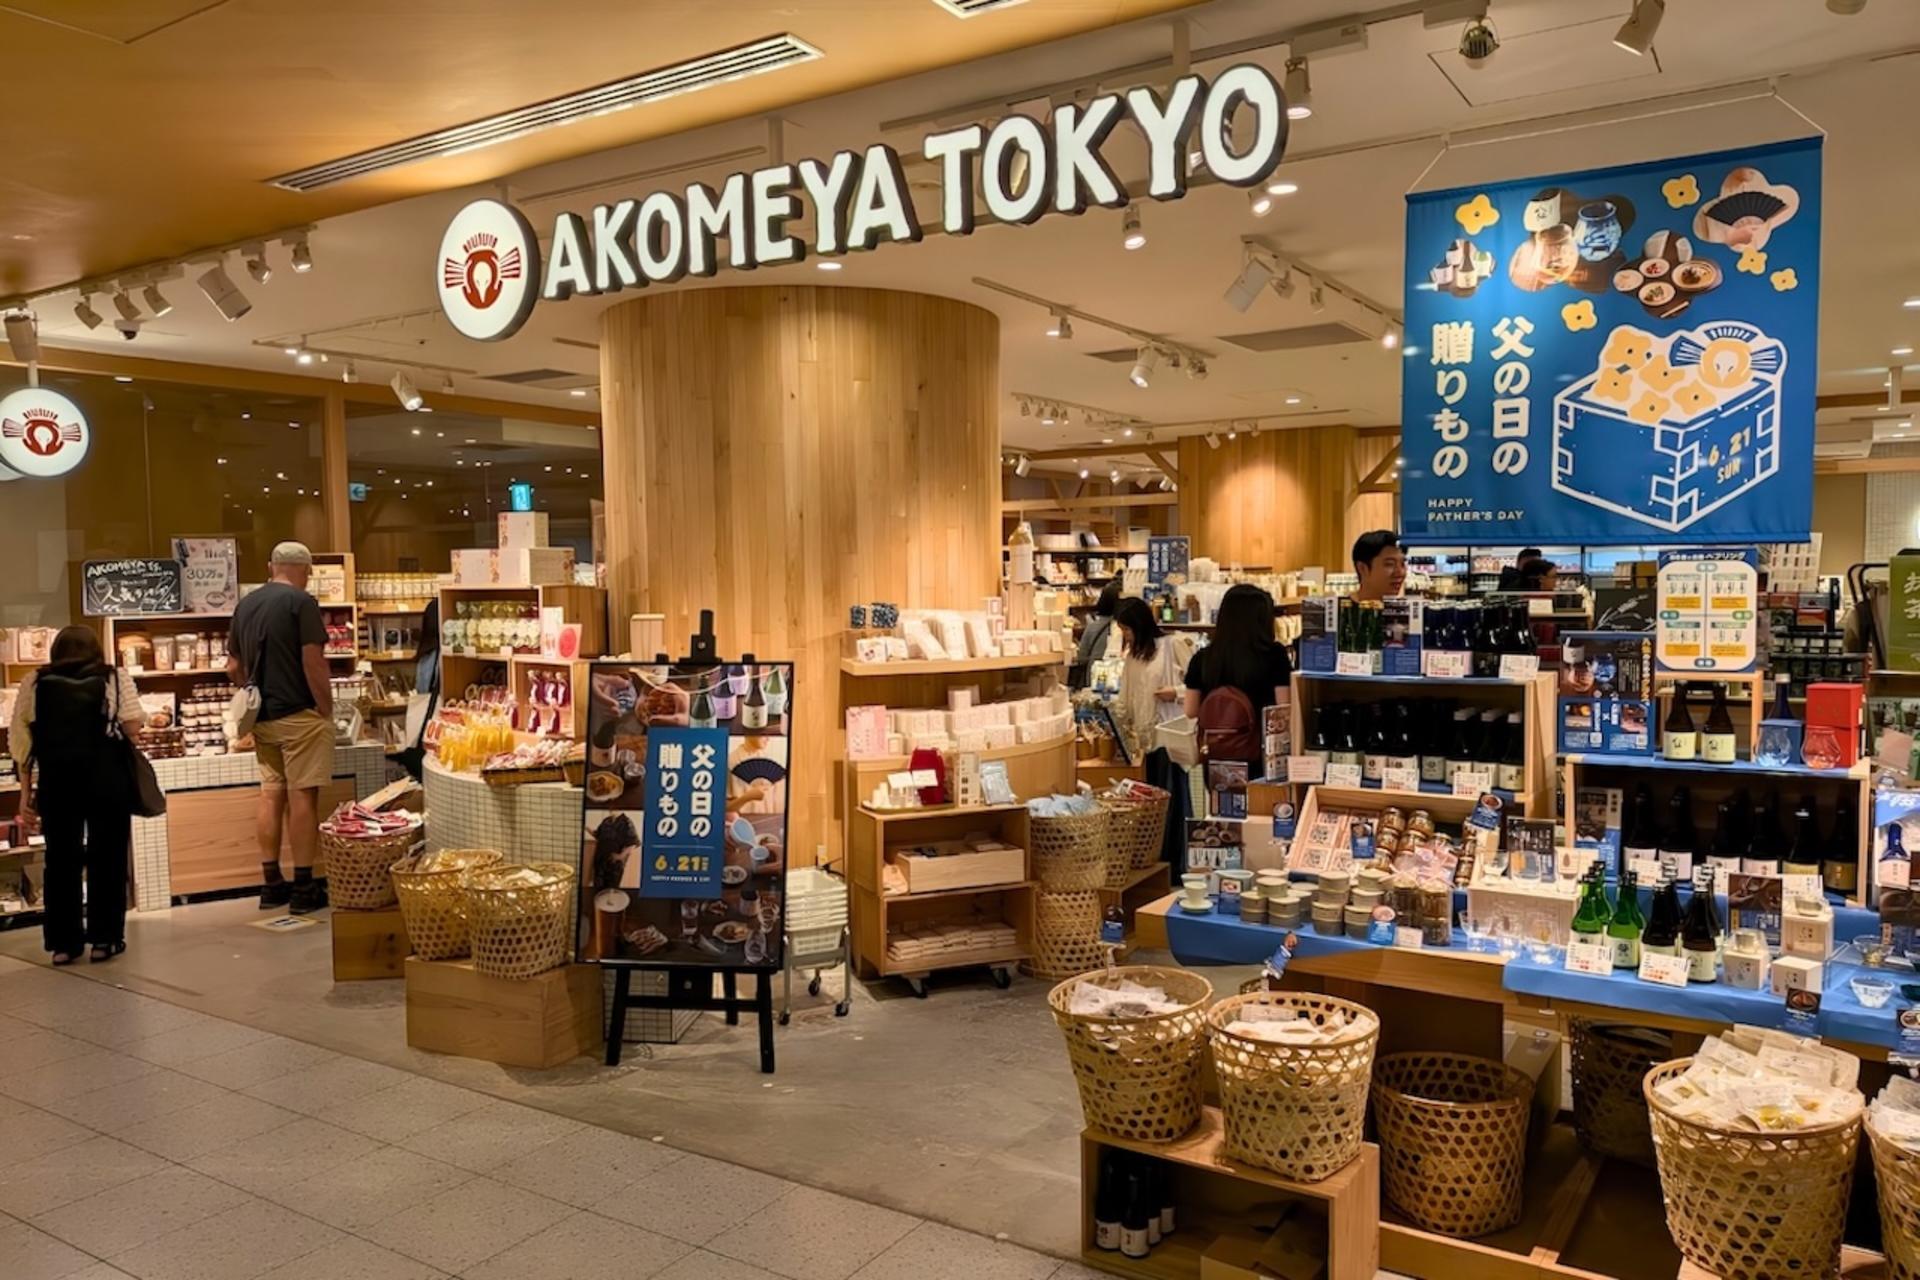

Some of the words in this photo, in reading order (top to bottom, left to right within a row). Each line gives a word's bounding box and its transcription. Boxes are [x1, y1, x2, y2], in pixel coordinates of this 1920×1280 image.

[543, 144, 918, 299] AKOMEYA
[923, 63, 1287, 235] TOKYO
[1430, 321, 1474, 479] 贈りもの
[1490, 316, 1535, 476] 父の日の
[1427, 498, 1473, 508] HAPPY
[1427, 511, 1493, 522] FATHER'S
[1497, 510, 1525, 521] DAY
[1716, 457, 1742, 485] SUN
[657, 744, 683, 837] 贈りもの
[690, 744, 716, 837] 父の日の
[655, 854, 700, 871] 6.21
